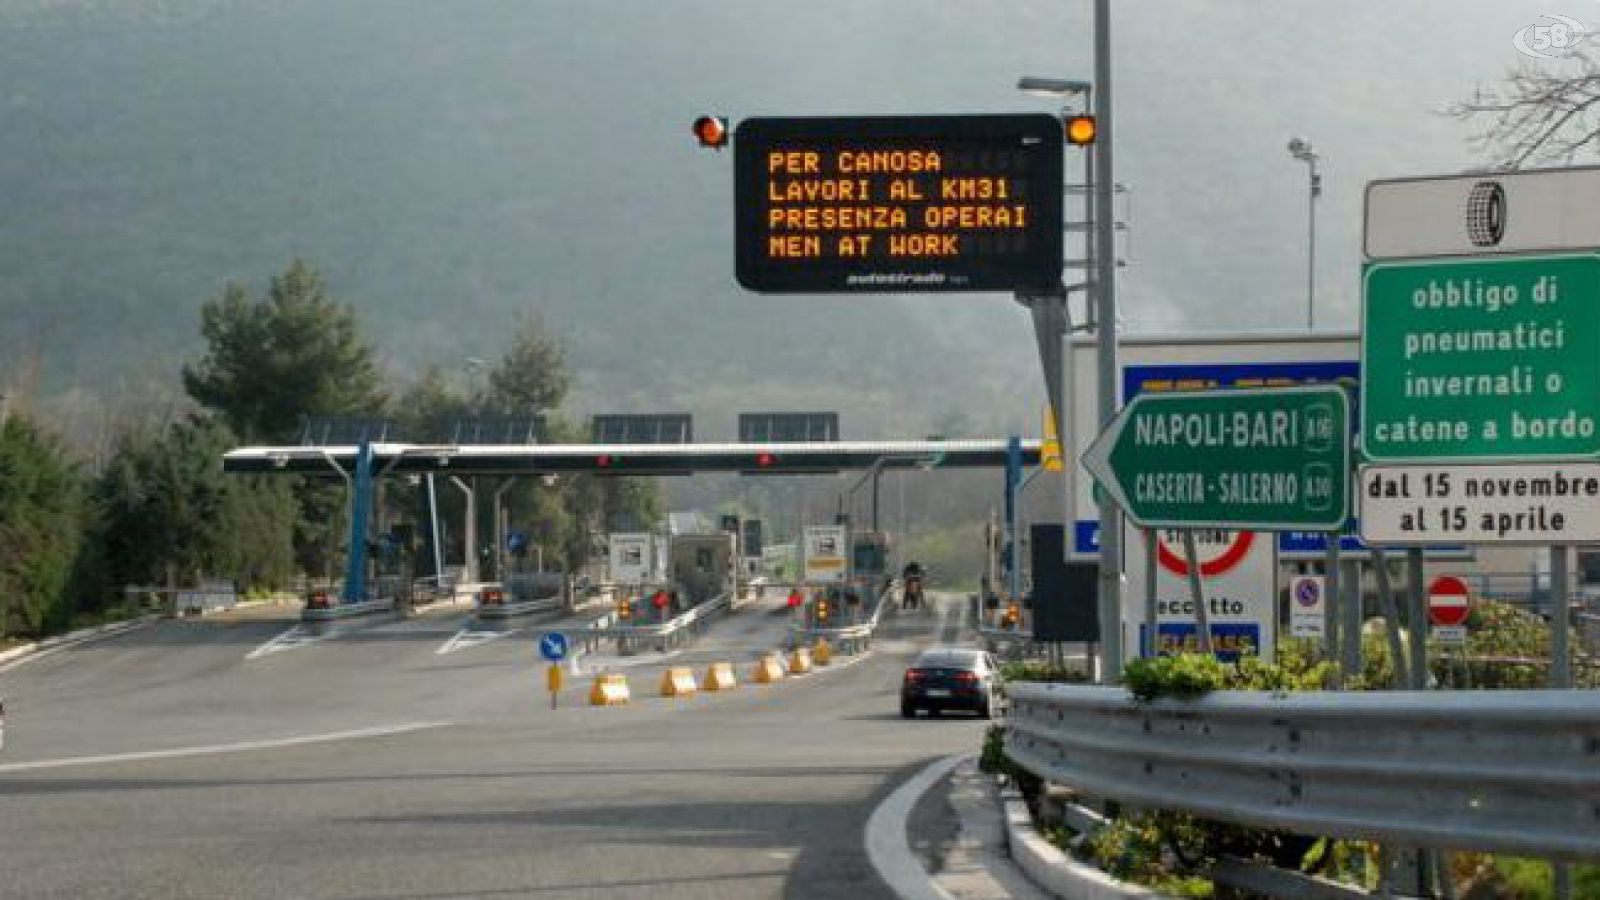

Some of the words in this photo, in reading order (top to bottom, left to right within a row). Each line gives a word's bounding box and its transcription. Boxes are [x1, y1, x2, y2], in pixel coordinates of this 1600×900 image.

[768, 152, 819, 172] PER
[838, 151, 941, 172] CANOSA
[768, 180, 870, 201] LAVORI
[890, 179, 922, 199] AL
[941, 178, 1009, 199] KM31
[768, 207, 906, 228] PRESENZA
[925, 206, 1026, 228] OPERAI
[768, 235, 820, 256] MEN
[838, 235, 871, 255] AT
[890, 234, 959, 255] WORK
[1412, 279, 1519, 312] obbligo
[1532, 276, 1558, 304] di
[1404, 320, 1565, 360] pneumatici
[1404, 366, 1532, 397] invernali
[1546, 372, 1562, 394] o
[1375, 414, 1469, 442] catene
[1482, 420, 1498, 440] a
[1511, 408, 1594, 440] bordo
[1135, 474, 1204, 504] CASERTA
[1219, 472, 1298, 504] SALERNO
[1367, 473, 1409, 498] dal
[1425, 472, 1450, 497] 15
[1465, 471, 1599, 497] novembre
[1400, 507, 1426, 531] al
[1440, 505, 1467, 531] 15
[1480, 505, 1565, 537] aprile
[1158, 598, 1244, 615] ecctto
